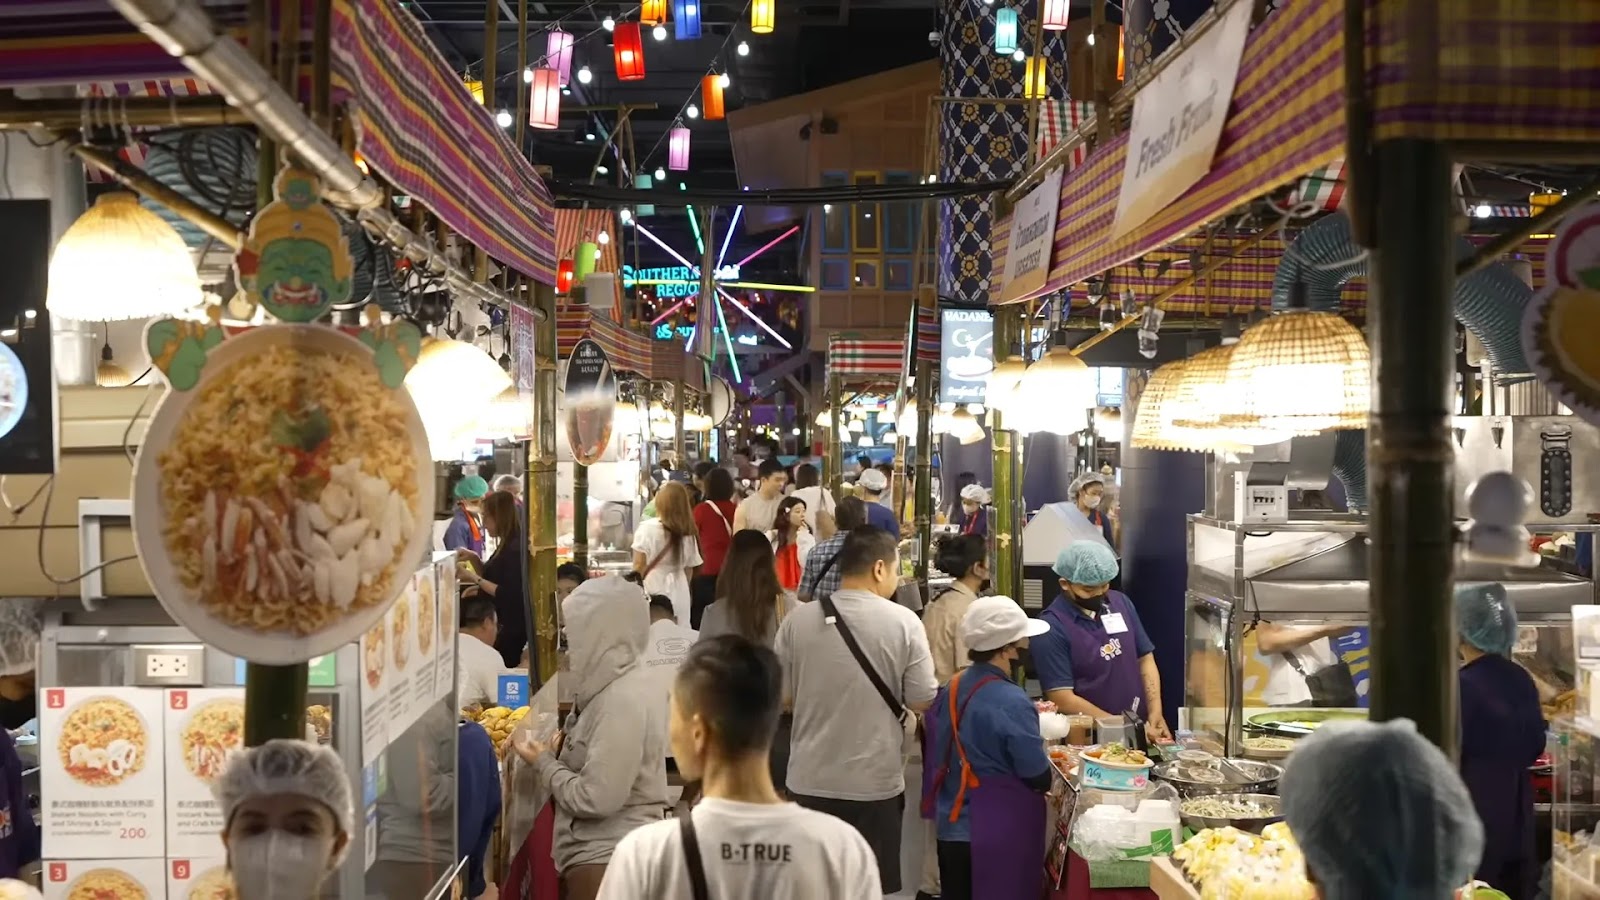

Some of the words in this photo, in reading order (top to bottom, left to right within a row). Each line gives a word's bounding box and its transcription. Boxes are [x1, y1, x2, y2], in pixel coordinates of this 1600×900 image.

[655, 284, 701, 298] REGIO
[52, 694, 61, 706] 1
[174, 695, 184, 708] 2
[119, 828, 146, 839] 200
[54, 867, 63, 880] 3
[177, 865, 186, 877] 9
